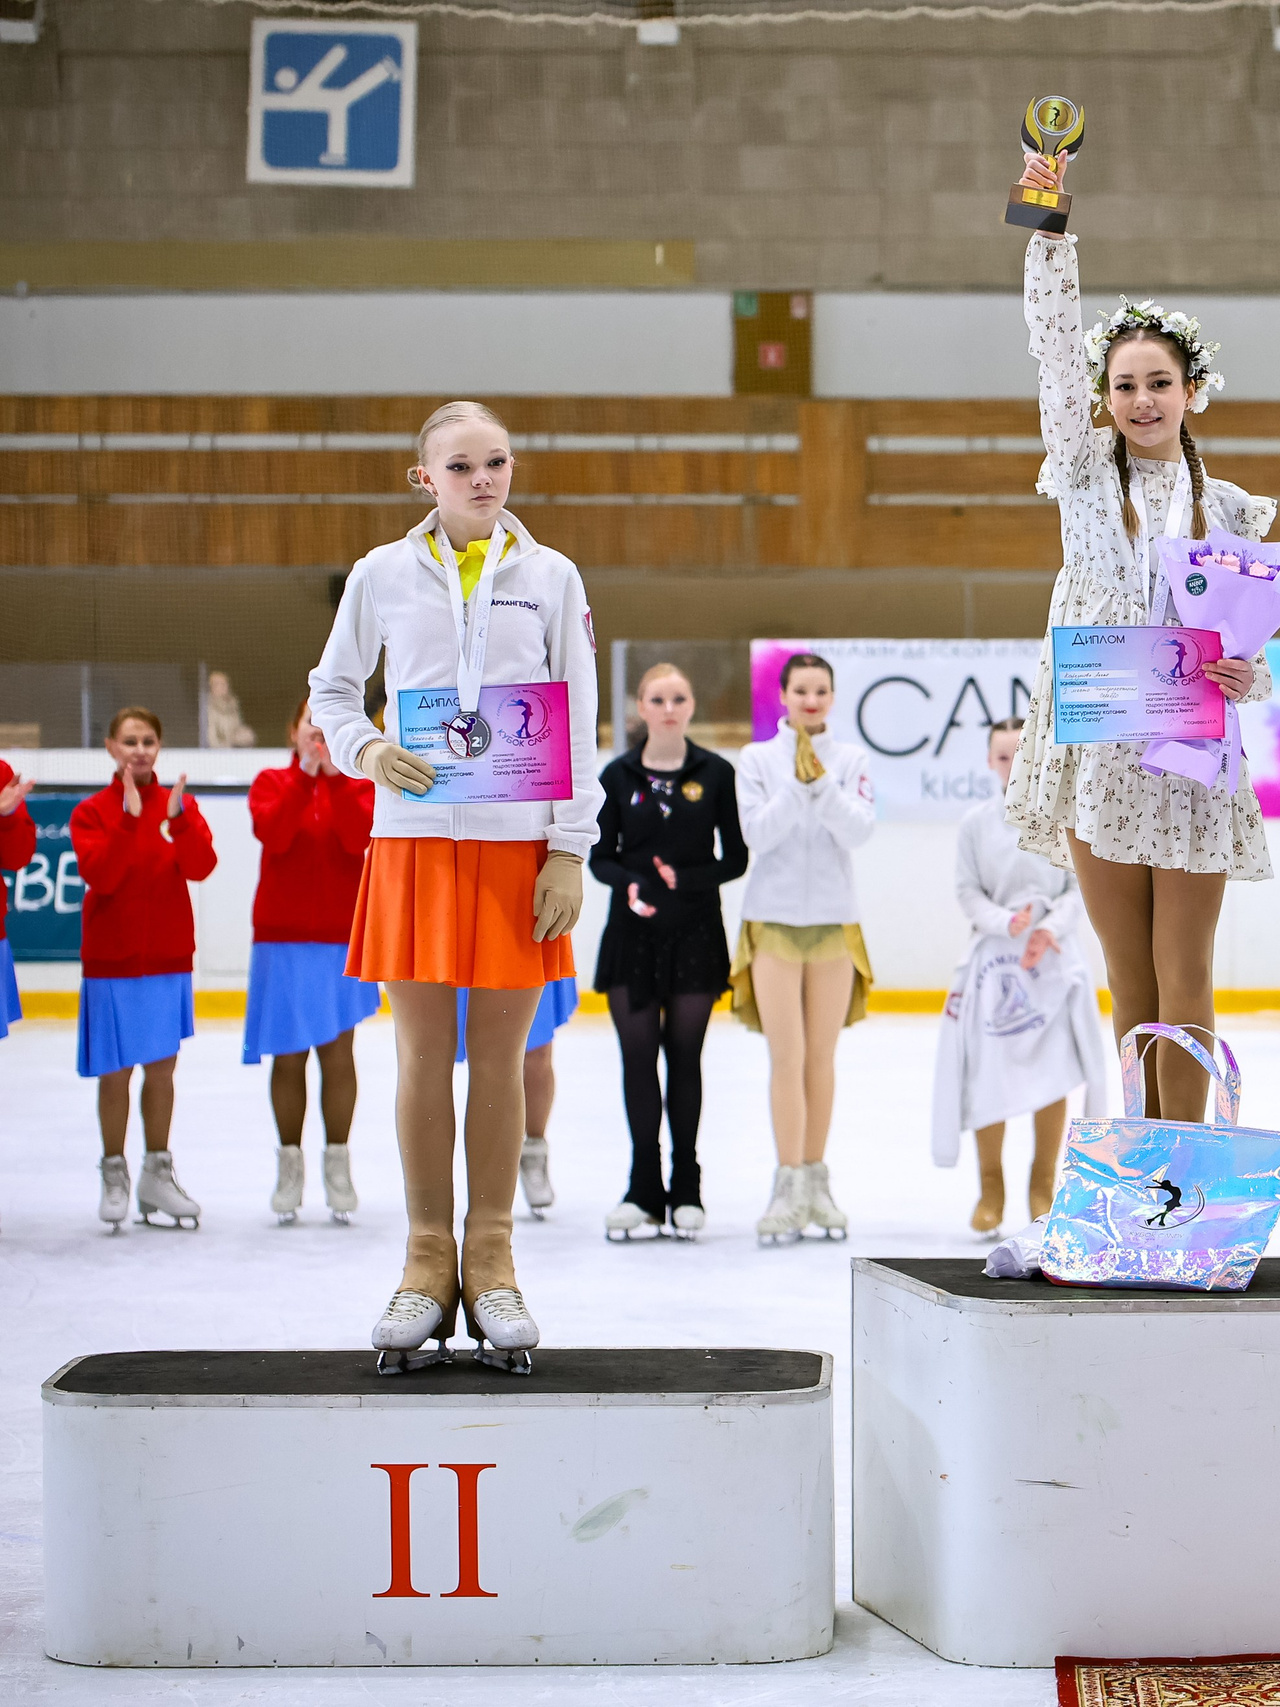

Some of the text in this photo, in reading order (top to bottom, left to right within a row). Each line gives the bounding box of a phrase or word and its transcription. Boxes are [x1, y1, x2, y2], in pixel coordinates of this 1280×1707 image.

[1151, 667, 1206, 686] КУБОК CAND
[418, 695, 460, 710] Дипло
[405, 725, 447, 733] Награждаетс
[497, 726, 553, 747] КУБОК CANDY
[920, 770, 994, 800] kids
[370, 1463, 498, 1597] II
